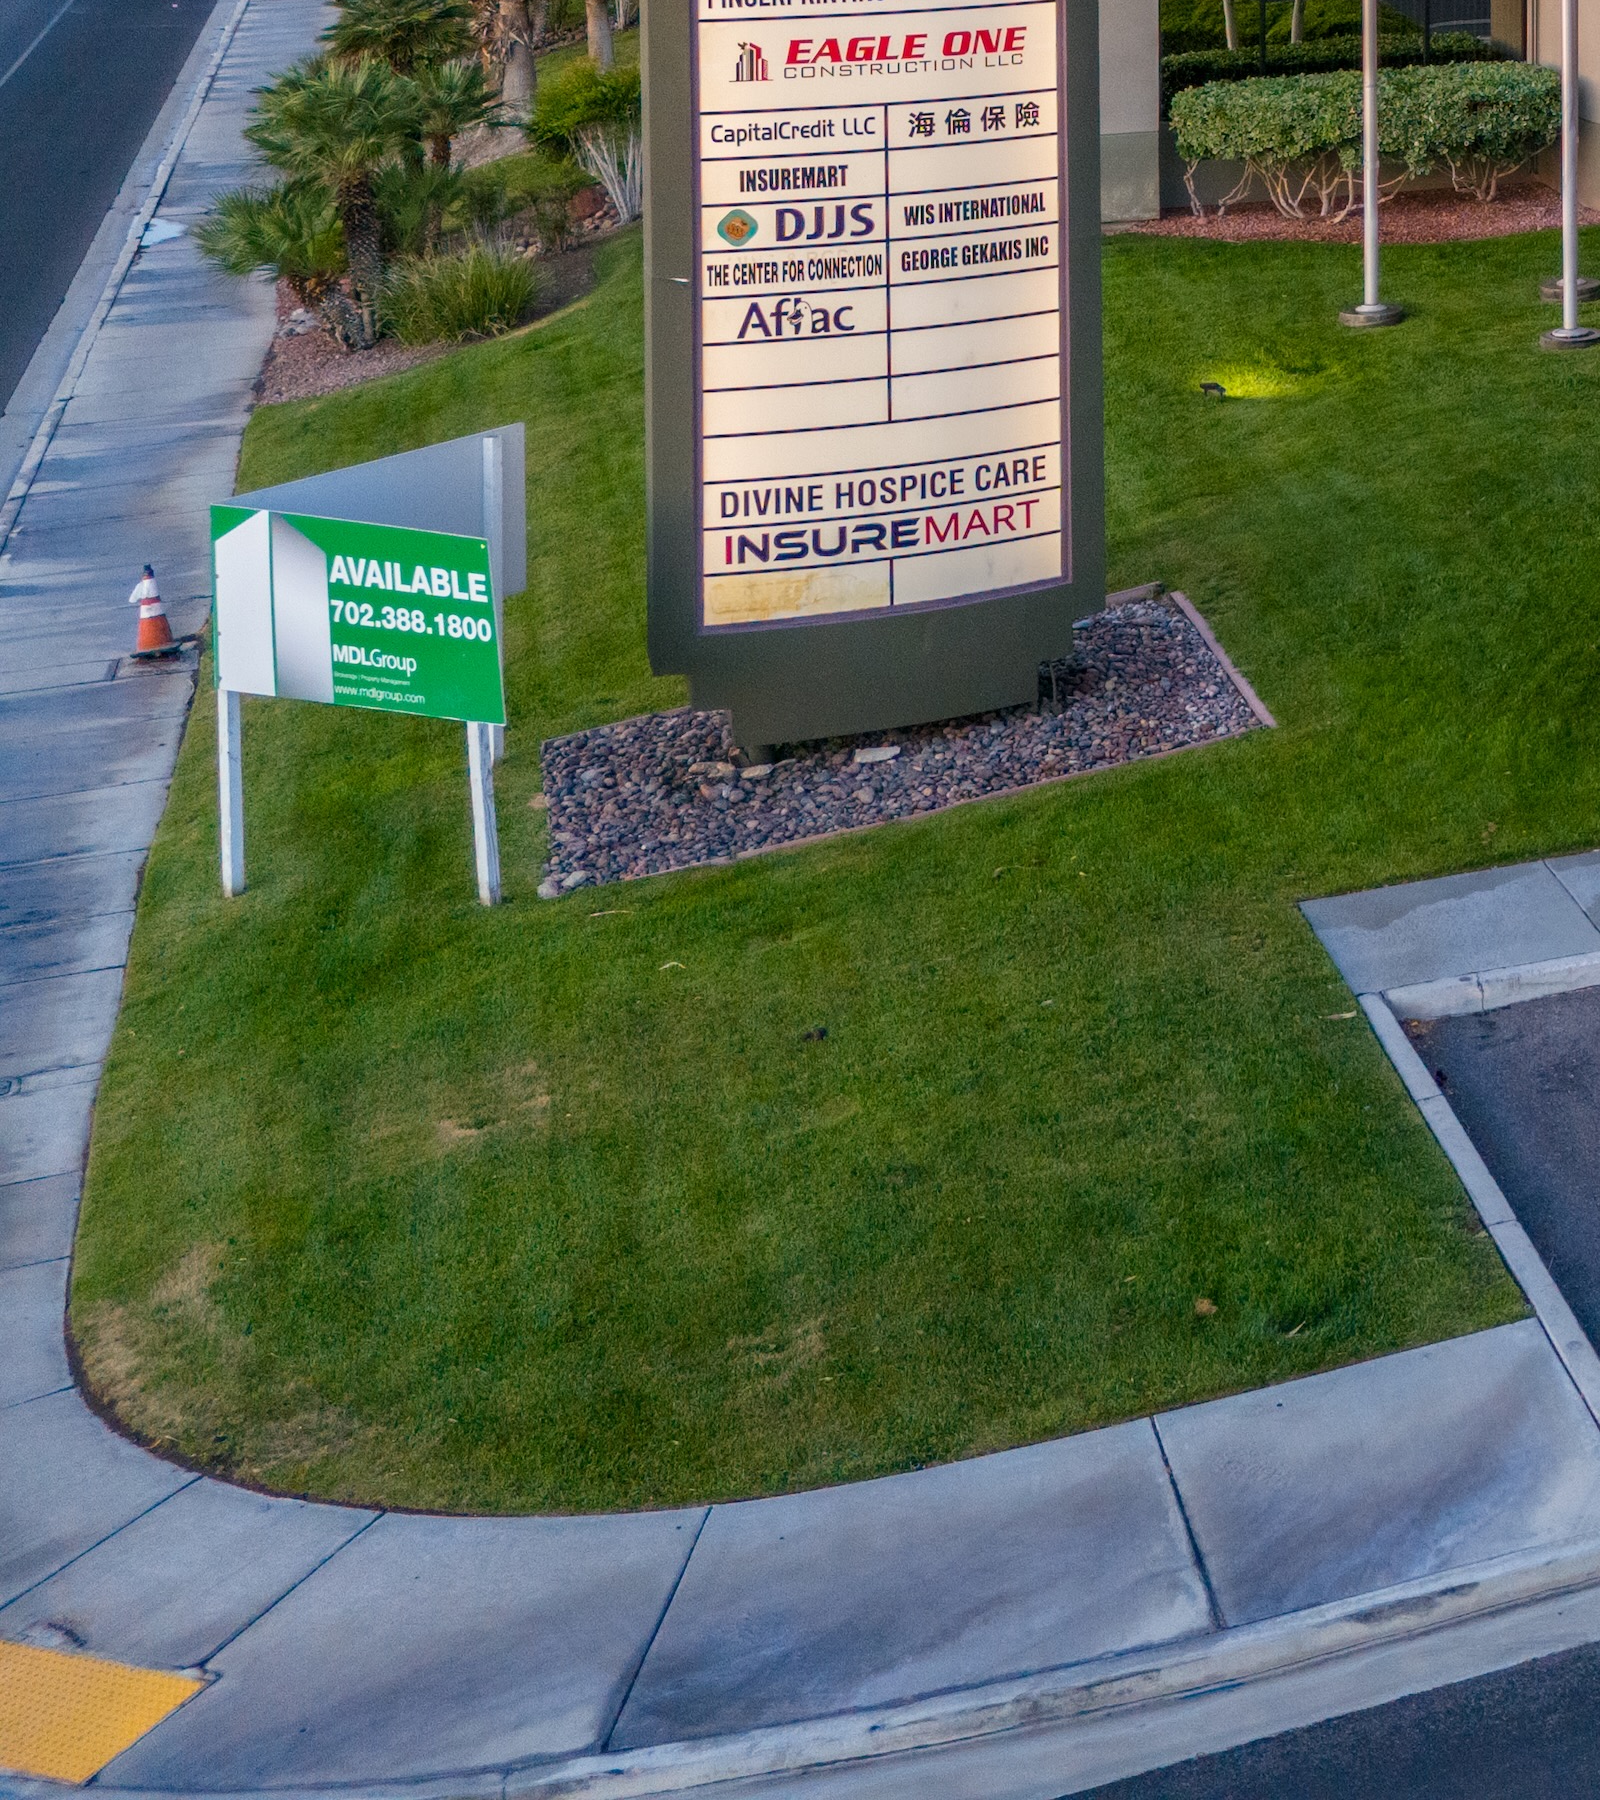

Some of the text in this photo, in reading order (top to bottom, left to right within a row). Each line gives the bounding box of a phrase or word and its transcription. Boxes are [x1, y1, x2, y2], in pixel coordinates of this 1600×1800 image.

[786, 27, 1026, 64] EAGLE ONE
[784, 54, 1022, 78] CONSTRUCTION LLC
[712, 117, 875, 146] CapitalCredit LLC
[909, 102, 1039, 137] 海倫保險
[740, 165, 848, 192] INSUREMART
[776, 203, 874, 241] DJJS
[904, 193, 1045, 226] WIS INTERNATIONAL
[707, 255, 881, 286] THE CENTER FOR CONNECTION
[902, 236, 1048, 271] GEORGE GEKAKIS INC
[738, 298, 854, 338] Aflac
[721, 455, 1045, 518] DIVINE HOSPICE CARE
[726, 499, 1039, 564] INSUREMART
[330, 555, 488, 602] AVAILABLE
[331, 600, 491, 642] 702.388.1800
[333, 644, 416, 677] MDLGroup
[334, 685, 425, 704] www.mdlgroup.com
